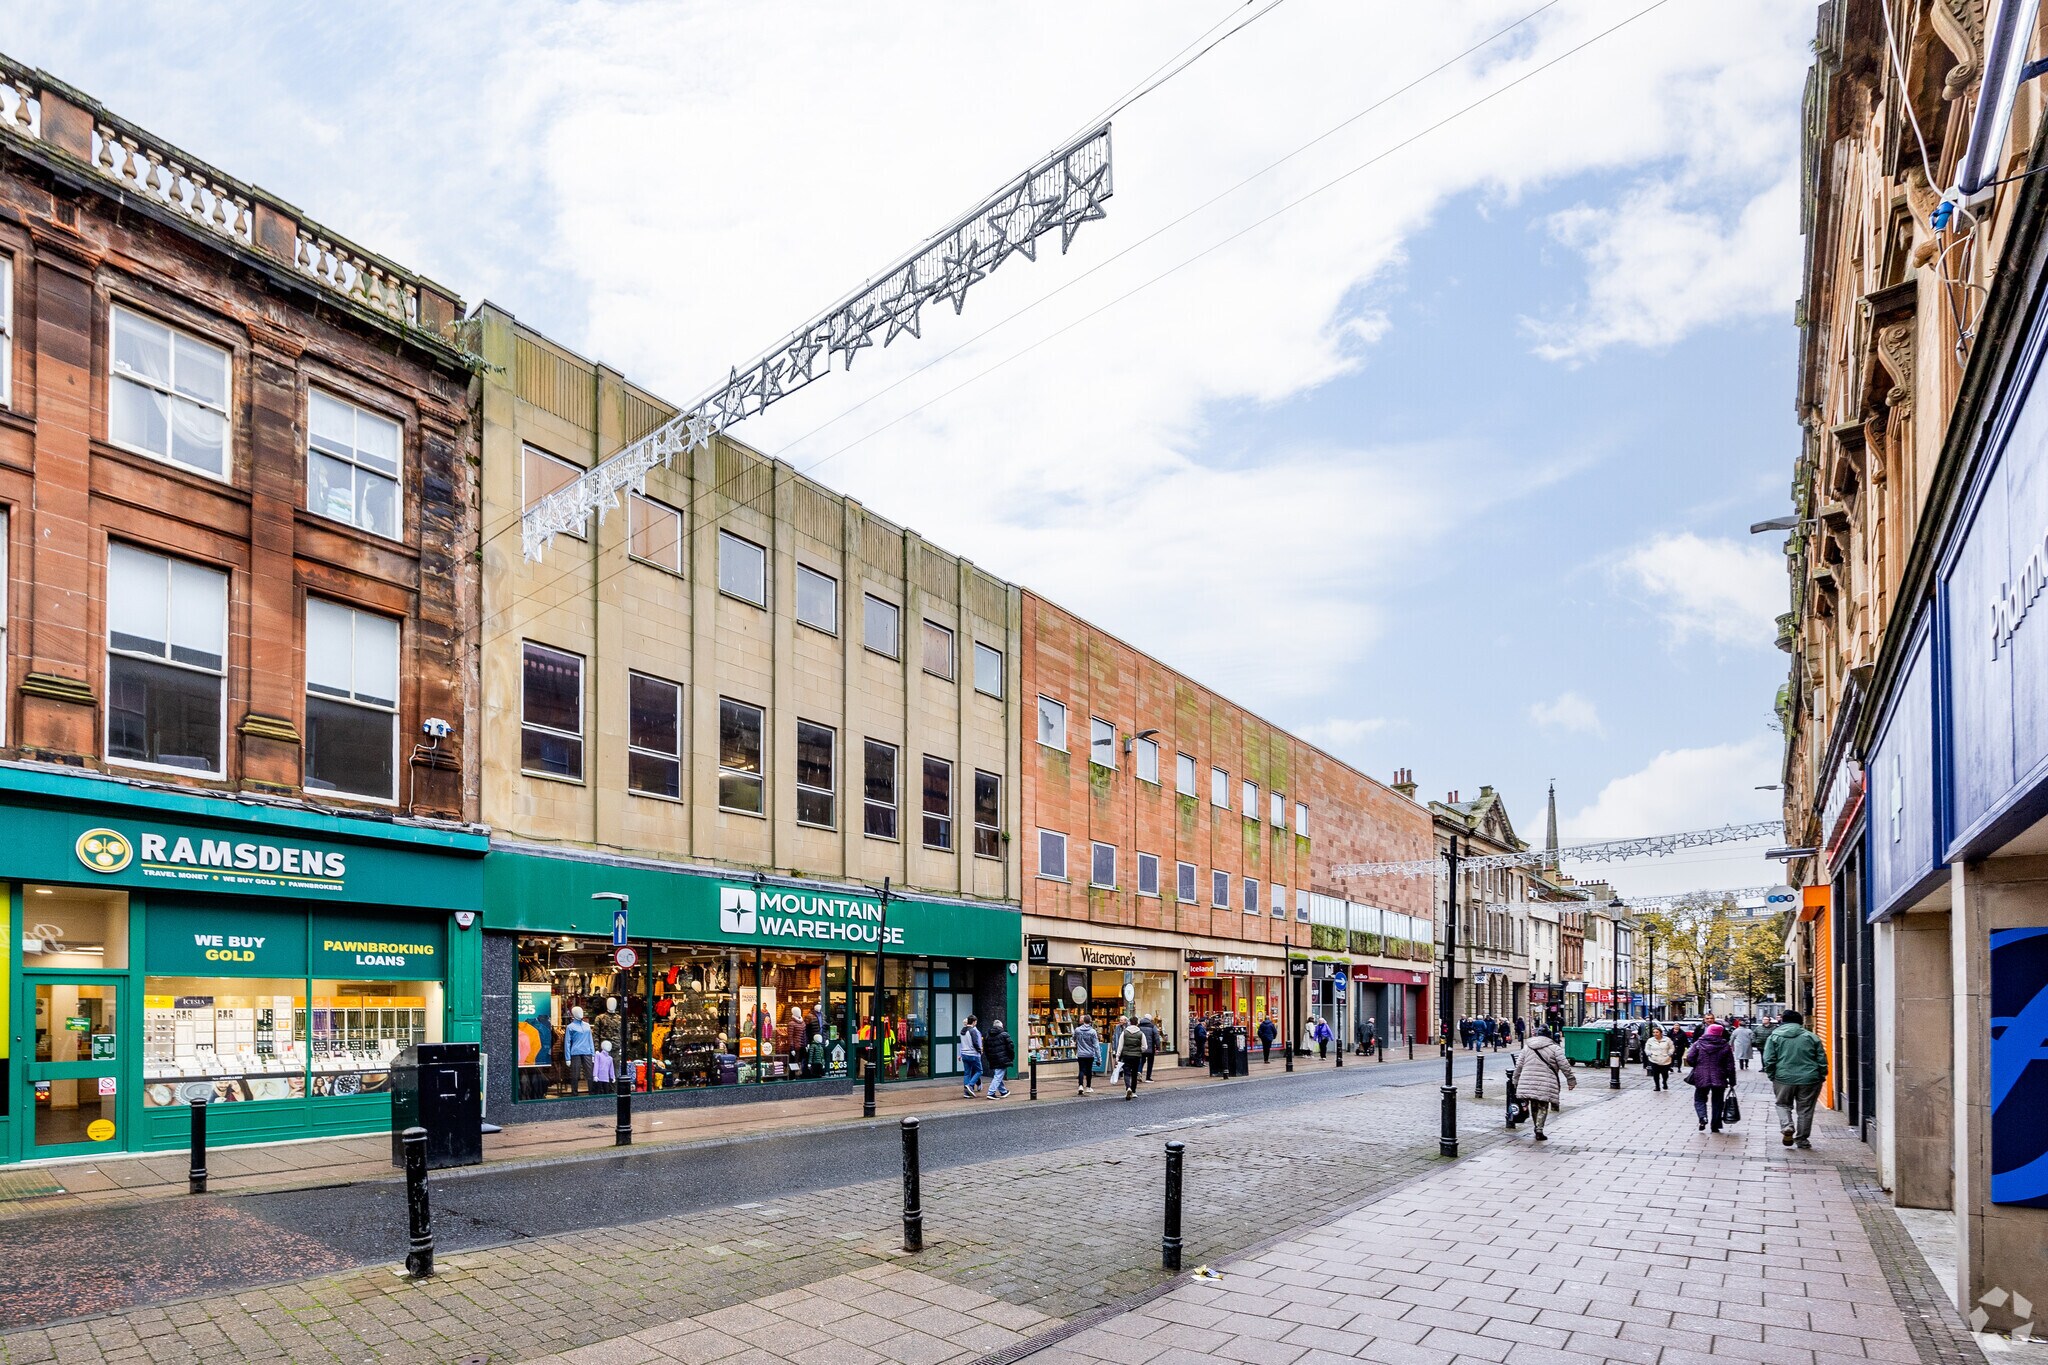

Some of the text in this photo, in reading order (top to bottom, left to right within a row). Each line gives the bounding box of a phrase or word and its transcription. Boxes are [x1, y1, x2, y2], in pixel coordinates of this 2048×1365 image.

[140, 832, 346, 878] RAMSDENS
[143, 869, 343, 891] TRAVEL MONEY WE BUY GOLD PAWNBROKERS
[760, 891, 882, 922] MOUNTAIN
[1769, 895, 1794, 903] TSB
[759, 916, 905, 945] WAREHOUSE
[194, 934, 266, 948] WE BUY
[323, 940, 434, 955] PAWNBROKING
[205, 949, 256, 962] GOLD
[1031, 943, 1044, 956] W
[1080, 946, 1136, 967] Waterstone's
[355, 954, 405, 966] LOANS
[1223, 955, 1258, 972] Iceland
